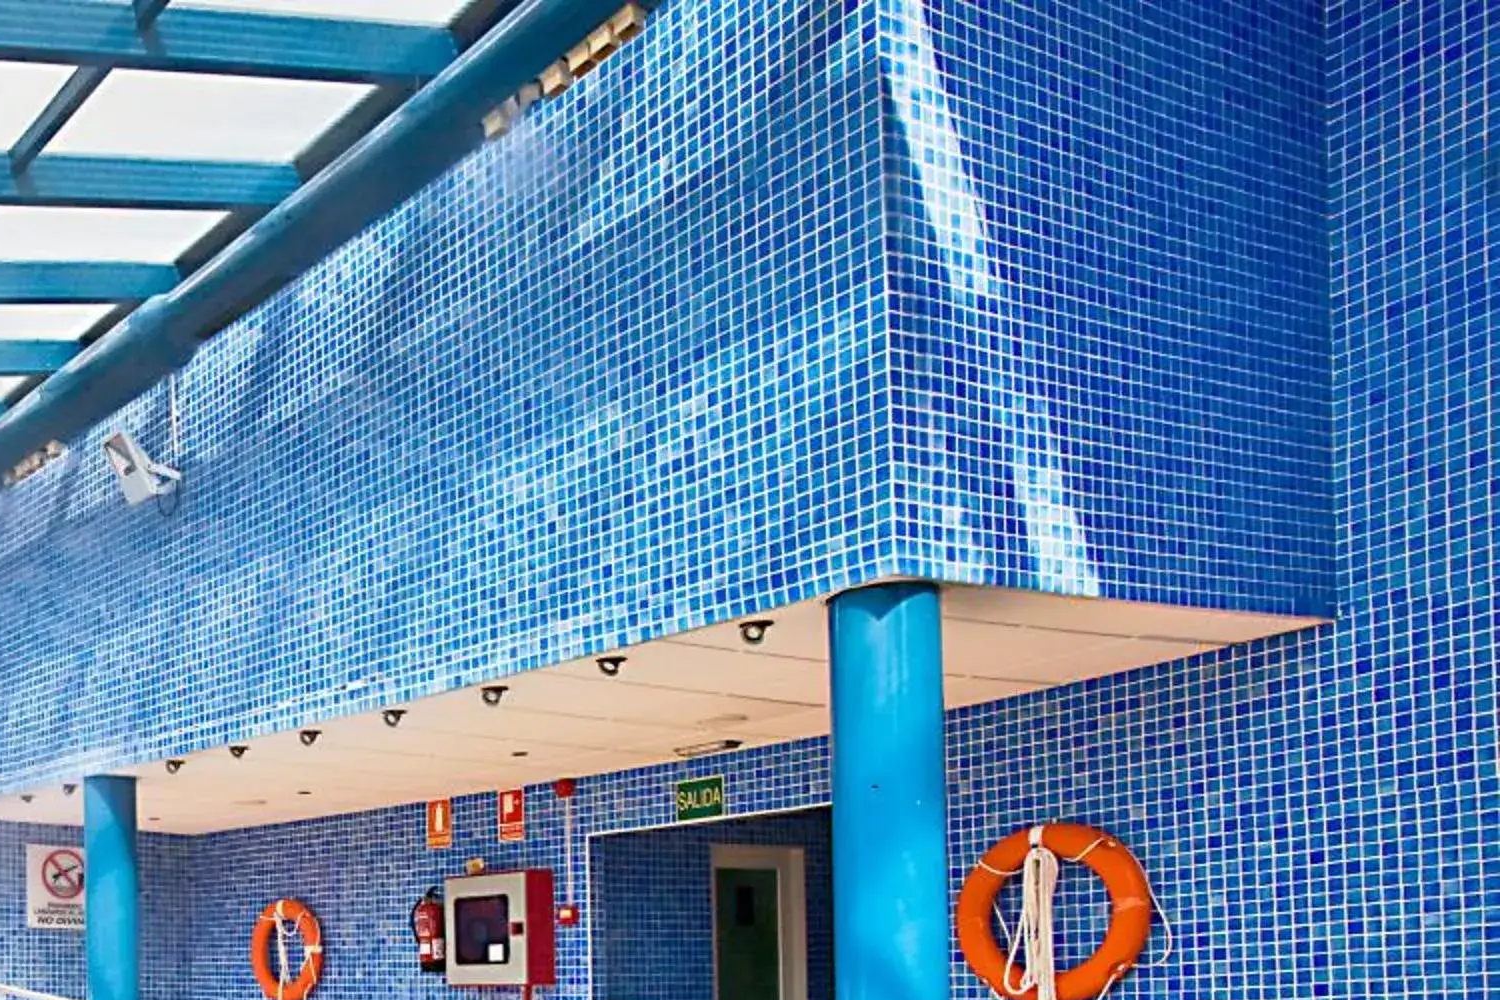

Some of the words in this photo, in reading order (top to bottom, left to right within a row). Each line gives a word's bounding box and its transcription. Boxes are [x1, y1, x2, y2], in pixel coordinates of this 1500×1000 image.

[678, 786, 721, 811] SALIDA
[37, 916, 54, 925] NO
[56, 917, 85, 925] DIVIN
